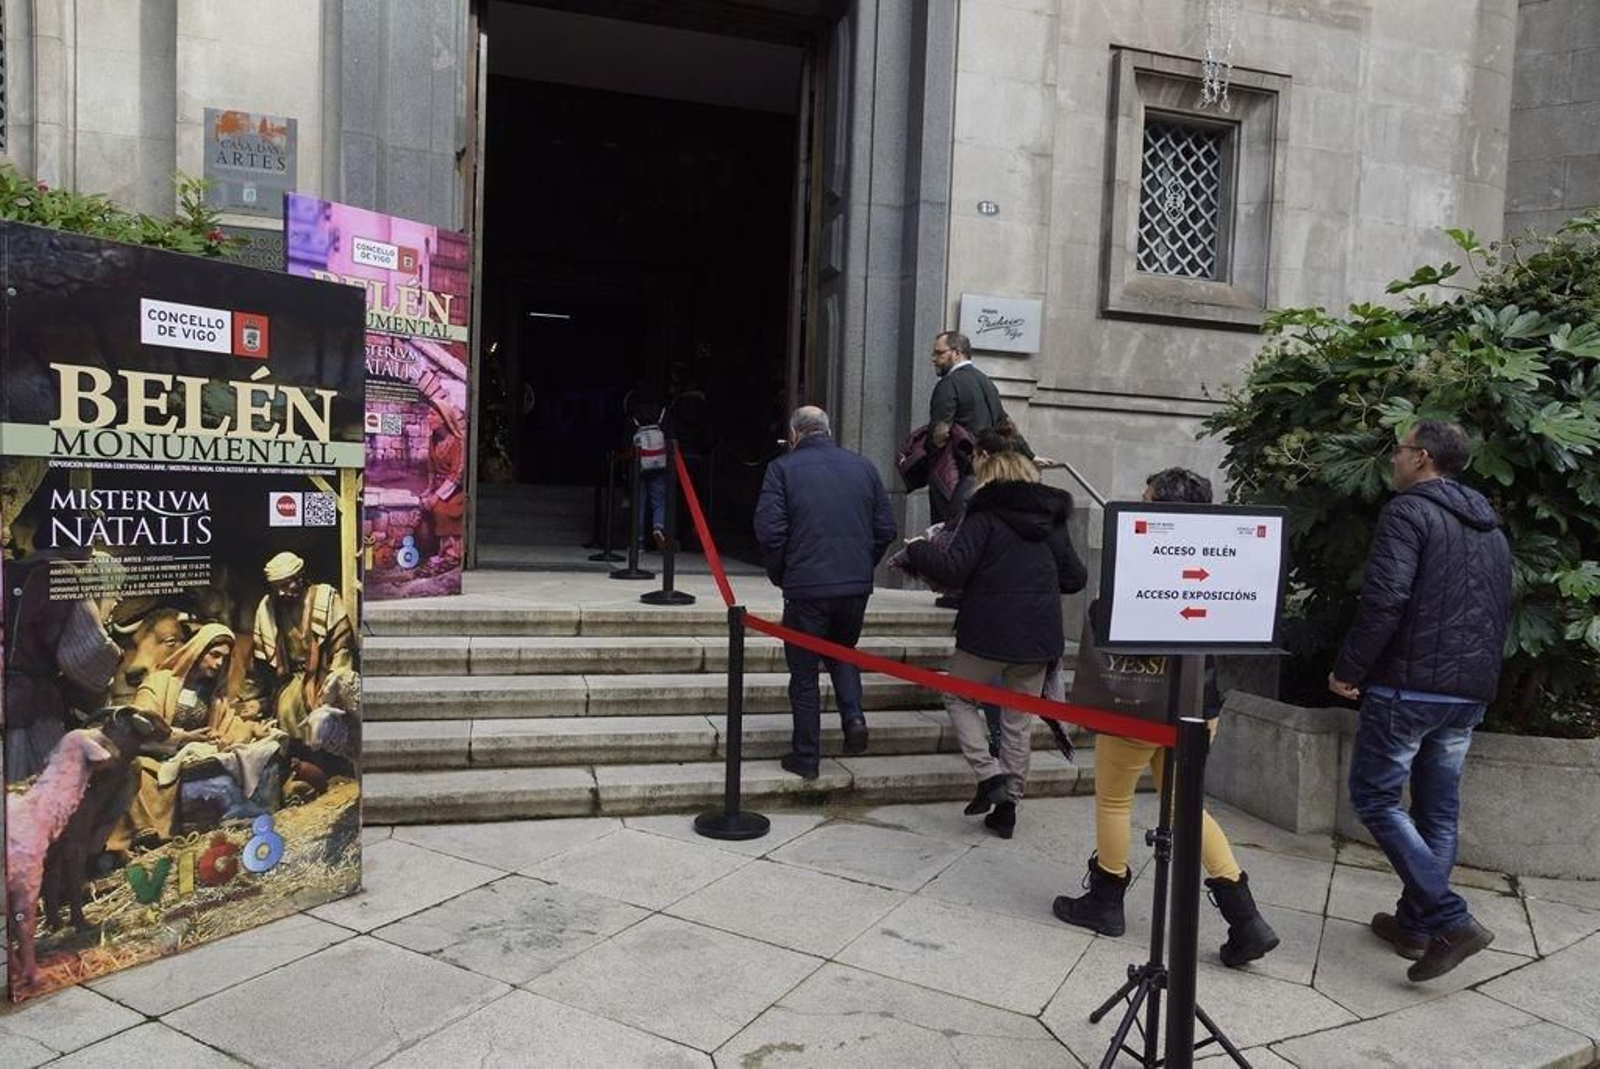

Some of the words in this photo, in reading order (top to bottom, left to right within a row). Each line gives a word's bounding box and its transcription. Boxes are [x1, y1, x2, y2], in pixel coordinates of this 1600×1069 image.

[221, 139, 252, 153] CASA
[257, 144, 280, 155] DAS
[216, 151, 287, 171] ARTES
[356, 243, 395, 257] CONCELLO
[360, 251, 370, 260] DE
[373, 252, 391, 264] VIGO
[309, 268, 454, 326] LÉN
[147, 308, 225, 330] CONCELLO
[365, 313, 453, 339] UMENTAL
[157, 324, 177, 338] DE
[182, 327, 217, 342] VIGO
[365, 344, 418, 362] STERIVM
[365, 358, 420, 379] ATALIS
[49, 362, 338, 443] BELÉN
[52, 428, 337, 465] MONUMENTAL
[50, 488, 211, 517] MISTERIVM
[49, 515, 212, 547] NATALIS
[1152, 546, 1196, 556] ACCESO
[1202, 545, 1237, 557] BELÉN
[1135, 589, 1179, 600] ACCESO
[1182, 589, 1257, 601] EXPOSICIÓNS
